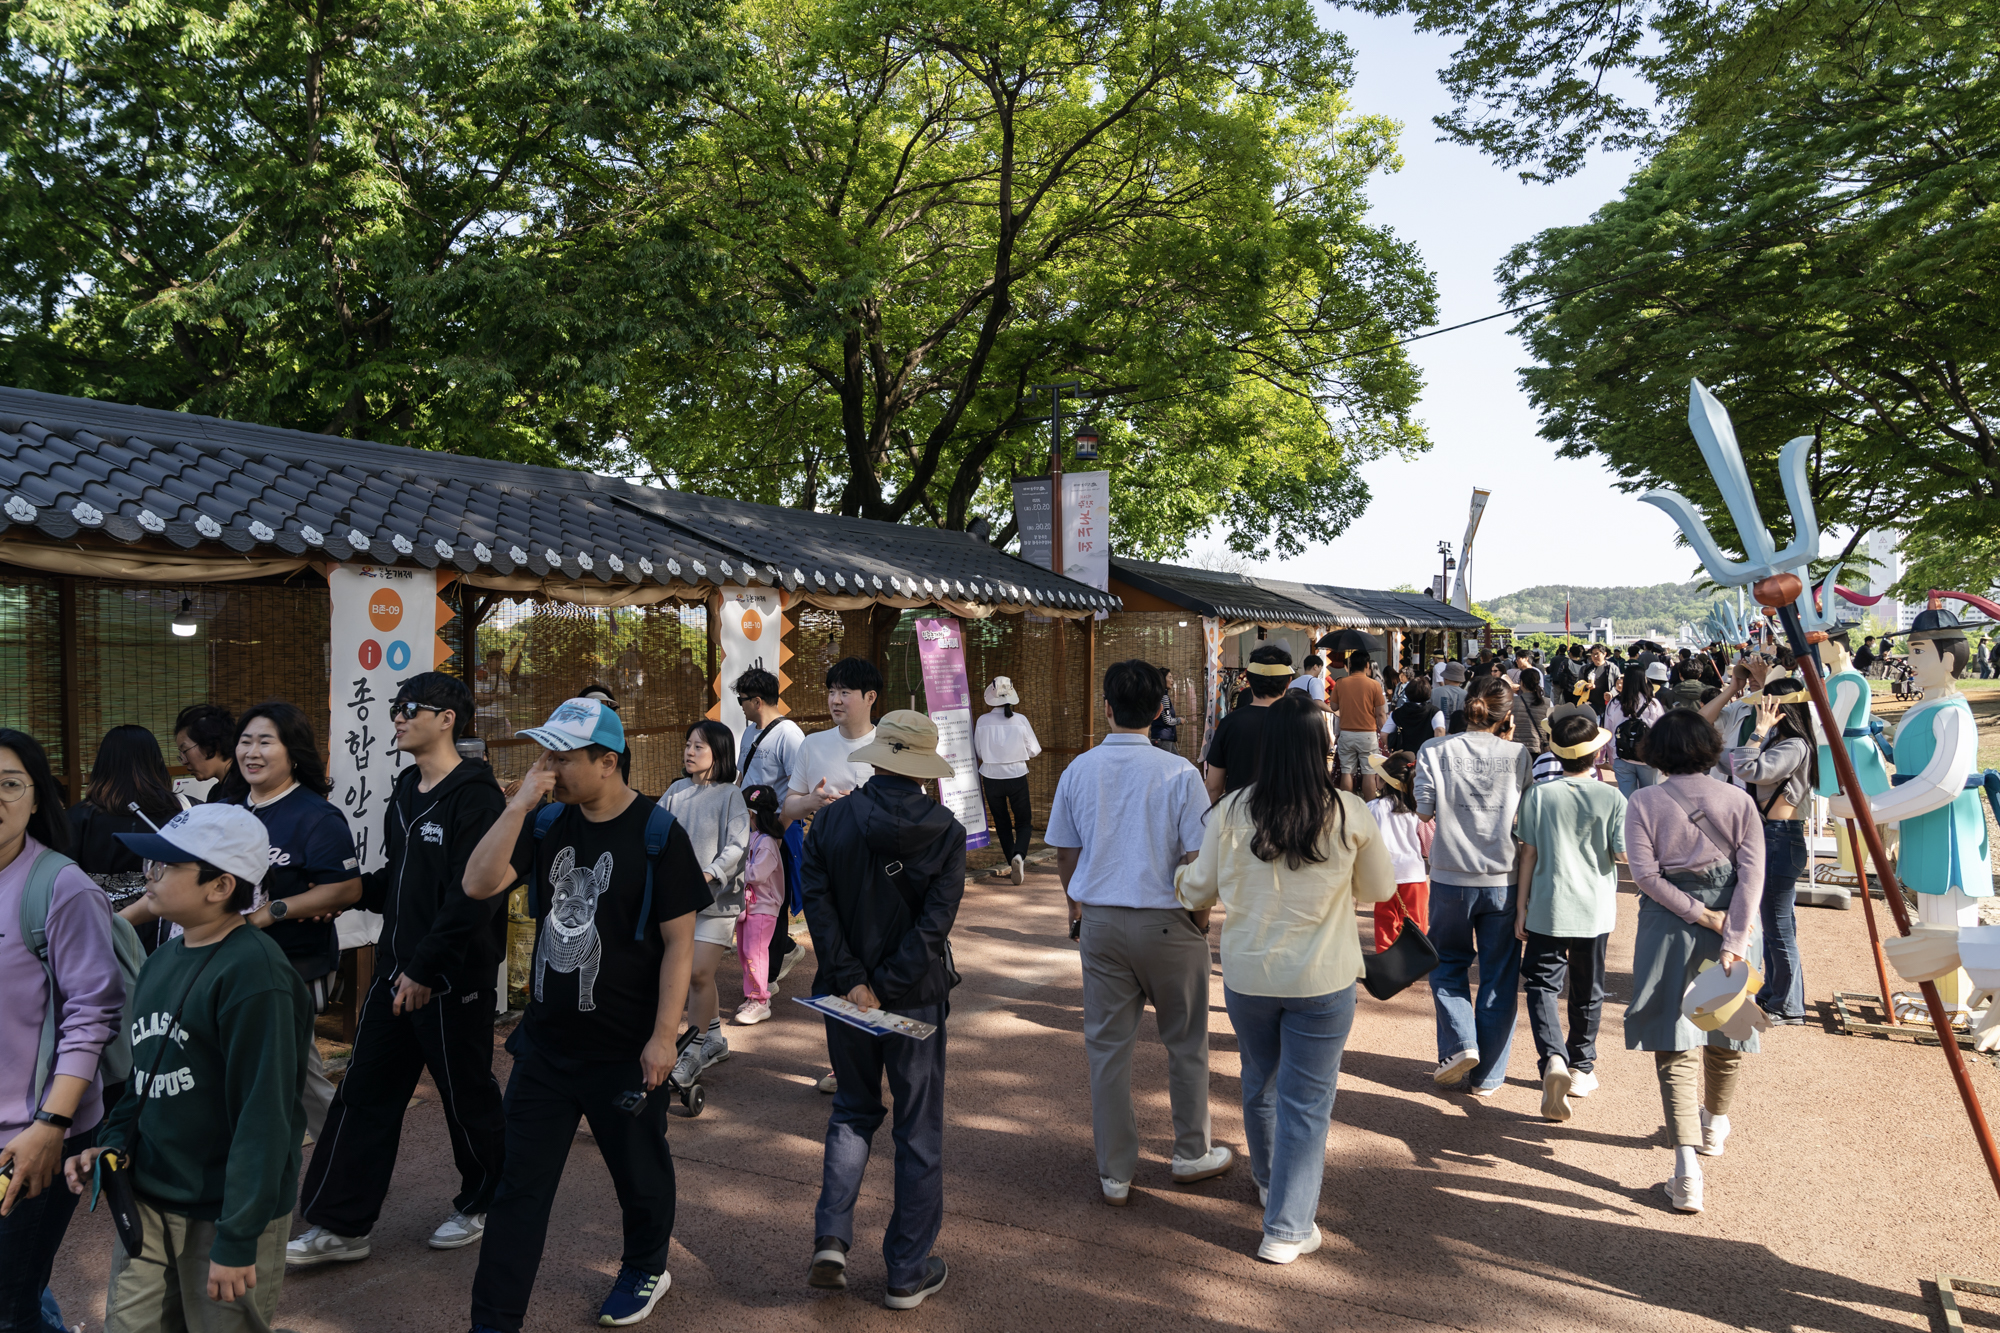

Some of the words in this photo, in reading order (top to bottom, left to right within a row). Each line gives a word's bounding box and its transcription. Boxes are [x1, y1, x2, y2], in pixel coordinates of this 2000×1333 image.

[384, 567, 413, 580] 논개제
[372, 604, 400, 615] B존-09
[1439, 756, 1520, 774] DISCOVERY
[461, 990, 479, 1004] 1993
[133, 1065, 196, 1099] APUS
